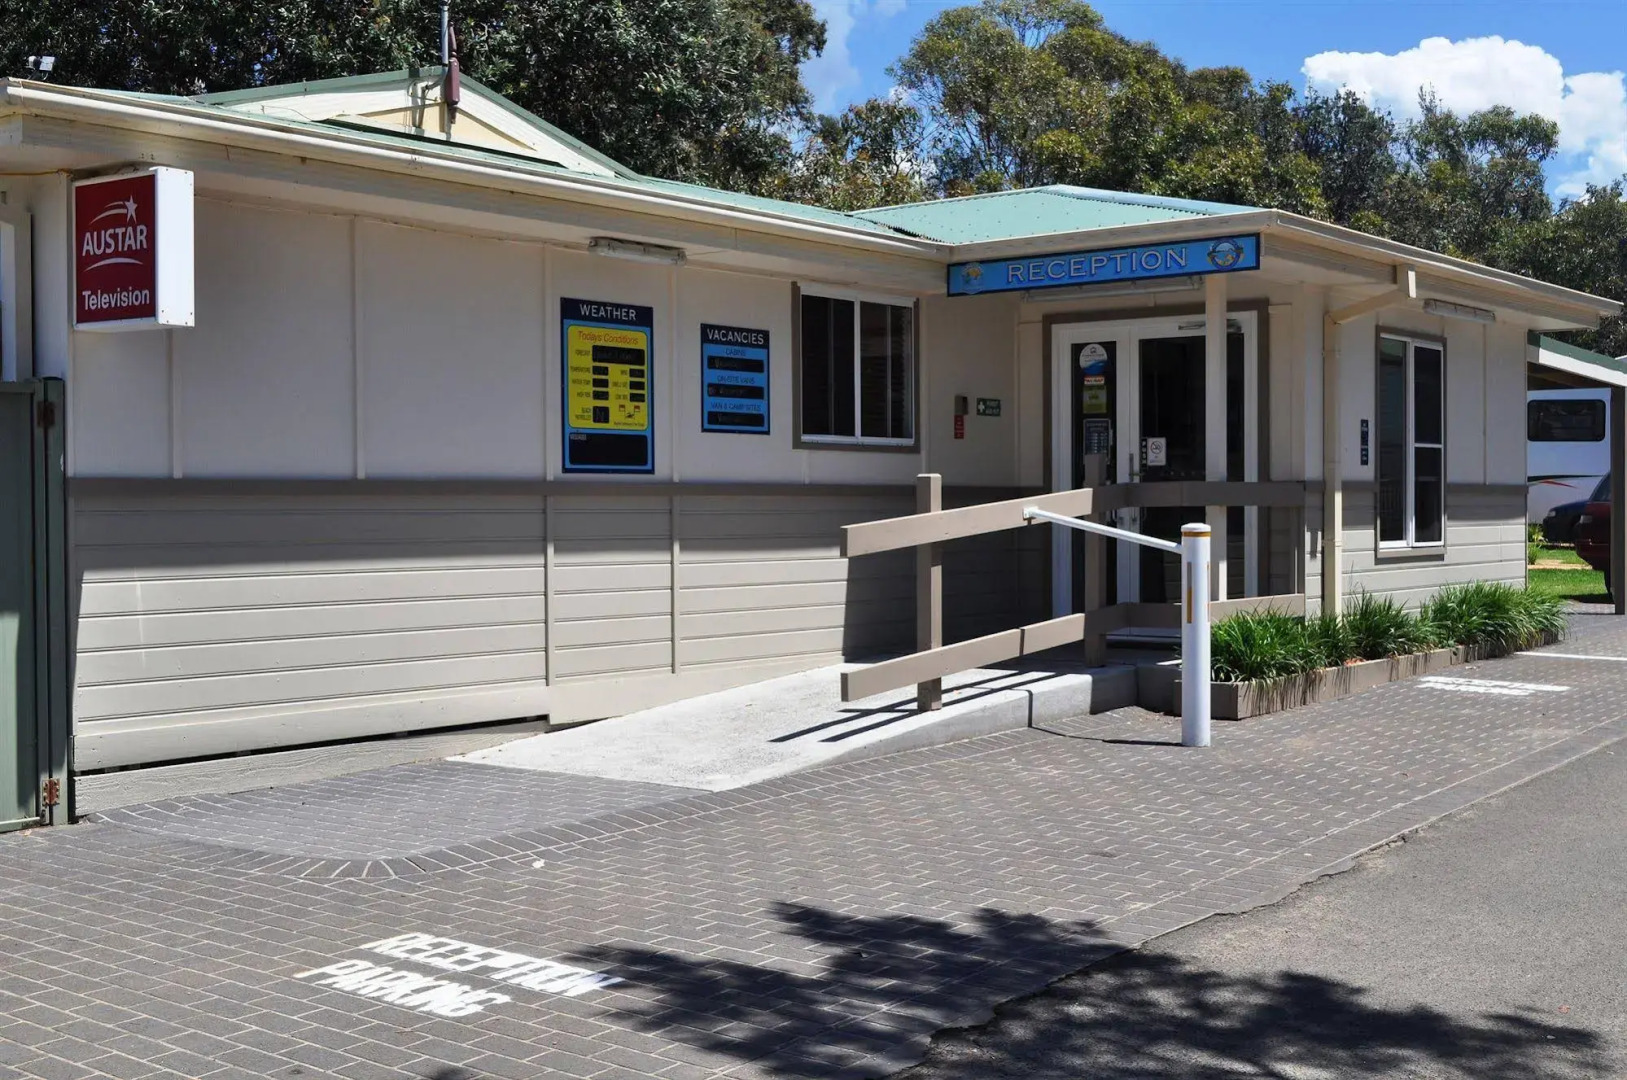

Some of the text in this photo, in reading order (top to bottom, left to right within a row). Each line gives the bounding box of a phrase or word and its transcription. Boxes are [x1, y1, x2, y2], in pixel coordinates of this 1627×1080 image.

[82, 224, 148, 257] AUSTAR
[1006, 247, 1188, 283] RECEPTION
[82, 287, 150, 311] Television
[579, 303, 637, 321] WEATHER
[577, 330, 639, 345] Todays Conditions
[706, 328, 765, 345] VACANCIES
[710, 401, 723, 409] VAN
[360, 931, 626, 997] RECEPTION
[293, 958, 513, 1017] PARKING
